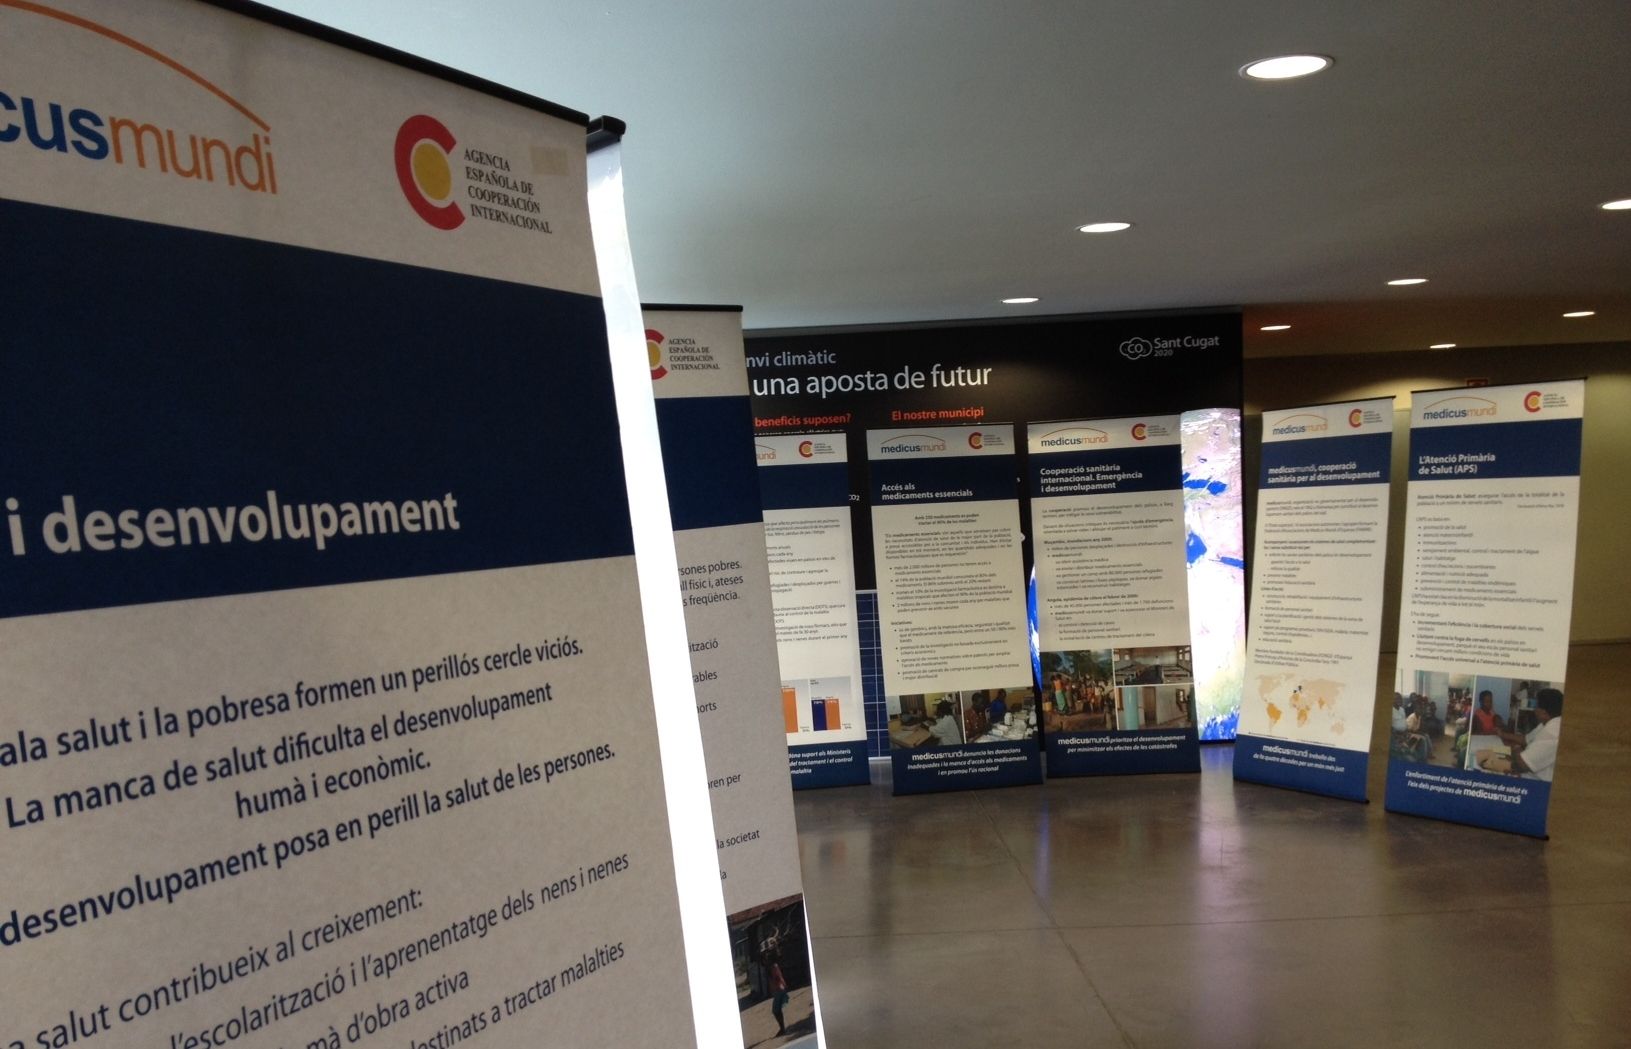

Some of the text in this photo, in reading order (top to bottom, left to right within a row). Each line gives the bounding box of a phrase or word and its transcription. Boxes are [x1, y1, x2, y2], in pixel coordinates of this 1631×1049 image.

[464, 148, 511, 172] AGENCIA
[465, 166, 534, 196] ESPAÑOLA DE
[468, 185, 541, 213] COOPERACIÓN
[470, 203, 553, 234] INTERNACIONAL
[669, 346, 701, 354] ESPAÑOLA
[1154, 336, 1220, 350] Sant Cugat
[773, 350, 837, 367] climàtic
[1154, 349, 1174, 357] 2020
[753, 363, 992, 399] una aposta de futur
[754, 412, 852, 428] beneficis suposen?
[892, 407, 985, 421] El nostre municipi
[1424, 406, 1497, 420] medicusmundi
[1041, 433, 1109, 447] medicusmundi
[881, 442, 946, 454] medicusmundi
[1458, 453, 1496, 463] Primària
[1040, 463, 1121, 477] Cooperació sanitària
[1317, 470, 1380, 482] desenvolupament
[1418, 464, 1478, 475] de Salut (APS)
[1040, 471, 1143, 485] internacional. Emergència
[881, 482, 915, 492] Accés als
[881, 488, 974, 501] medicaments essencials
[1045, 482, 1117, 493] desenvolupament
[8, 491, 460, 556] i desenvolupament
[678, 564, 707, 576] sones
[715, 576, 744, 587] ateses
[57, 719, 132, 755] salut
[138, 711, 147, 739] i
[154, 707, 179, 736] la
[187, 692, 290, 738] pobresa
[296, 676, 376, 708] formen
[382, 671, 407, 692] un
[412, 653, 480, 692] perillós
[484, 644, 532, 672] cercle
[536, 635, 584, 662] viciós.
[6, 682, 552, 828] La manca de salut dificulta el desenvolupament
[236, 748, 431, 818] humà i econòmic.
[726, 774, 741, 787] per
[1463, 788, 1521, 804] medicusmundi
[0, 743, 616, 946] desenvolupament posa en perill la salut de les persones.
[726, 829, 760, 848] societat
[350, 963, 357, 987] i
[361, 907, 498, 983] l'aprenentatge
[502, 889, 535, 921] dels
[541, 875, 577, 904] nens
[579, 867, 586, 888] i
[588, 852, 630, 885] nenes
[37, 888, 423, 1049] salut contribueix al creixement:
[491, 1004, 501, 1024] a
[504, 975, 557, 1017] tractar
[561, 940, 625, 989] malalties
[347, 999, 410, 1044] d'obra
[415, 969, 470, 1012] activa
